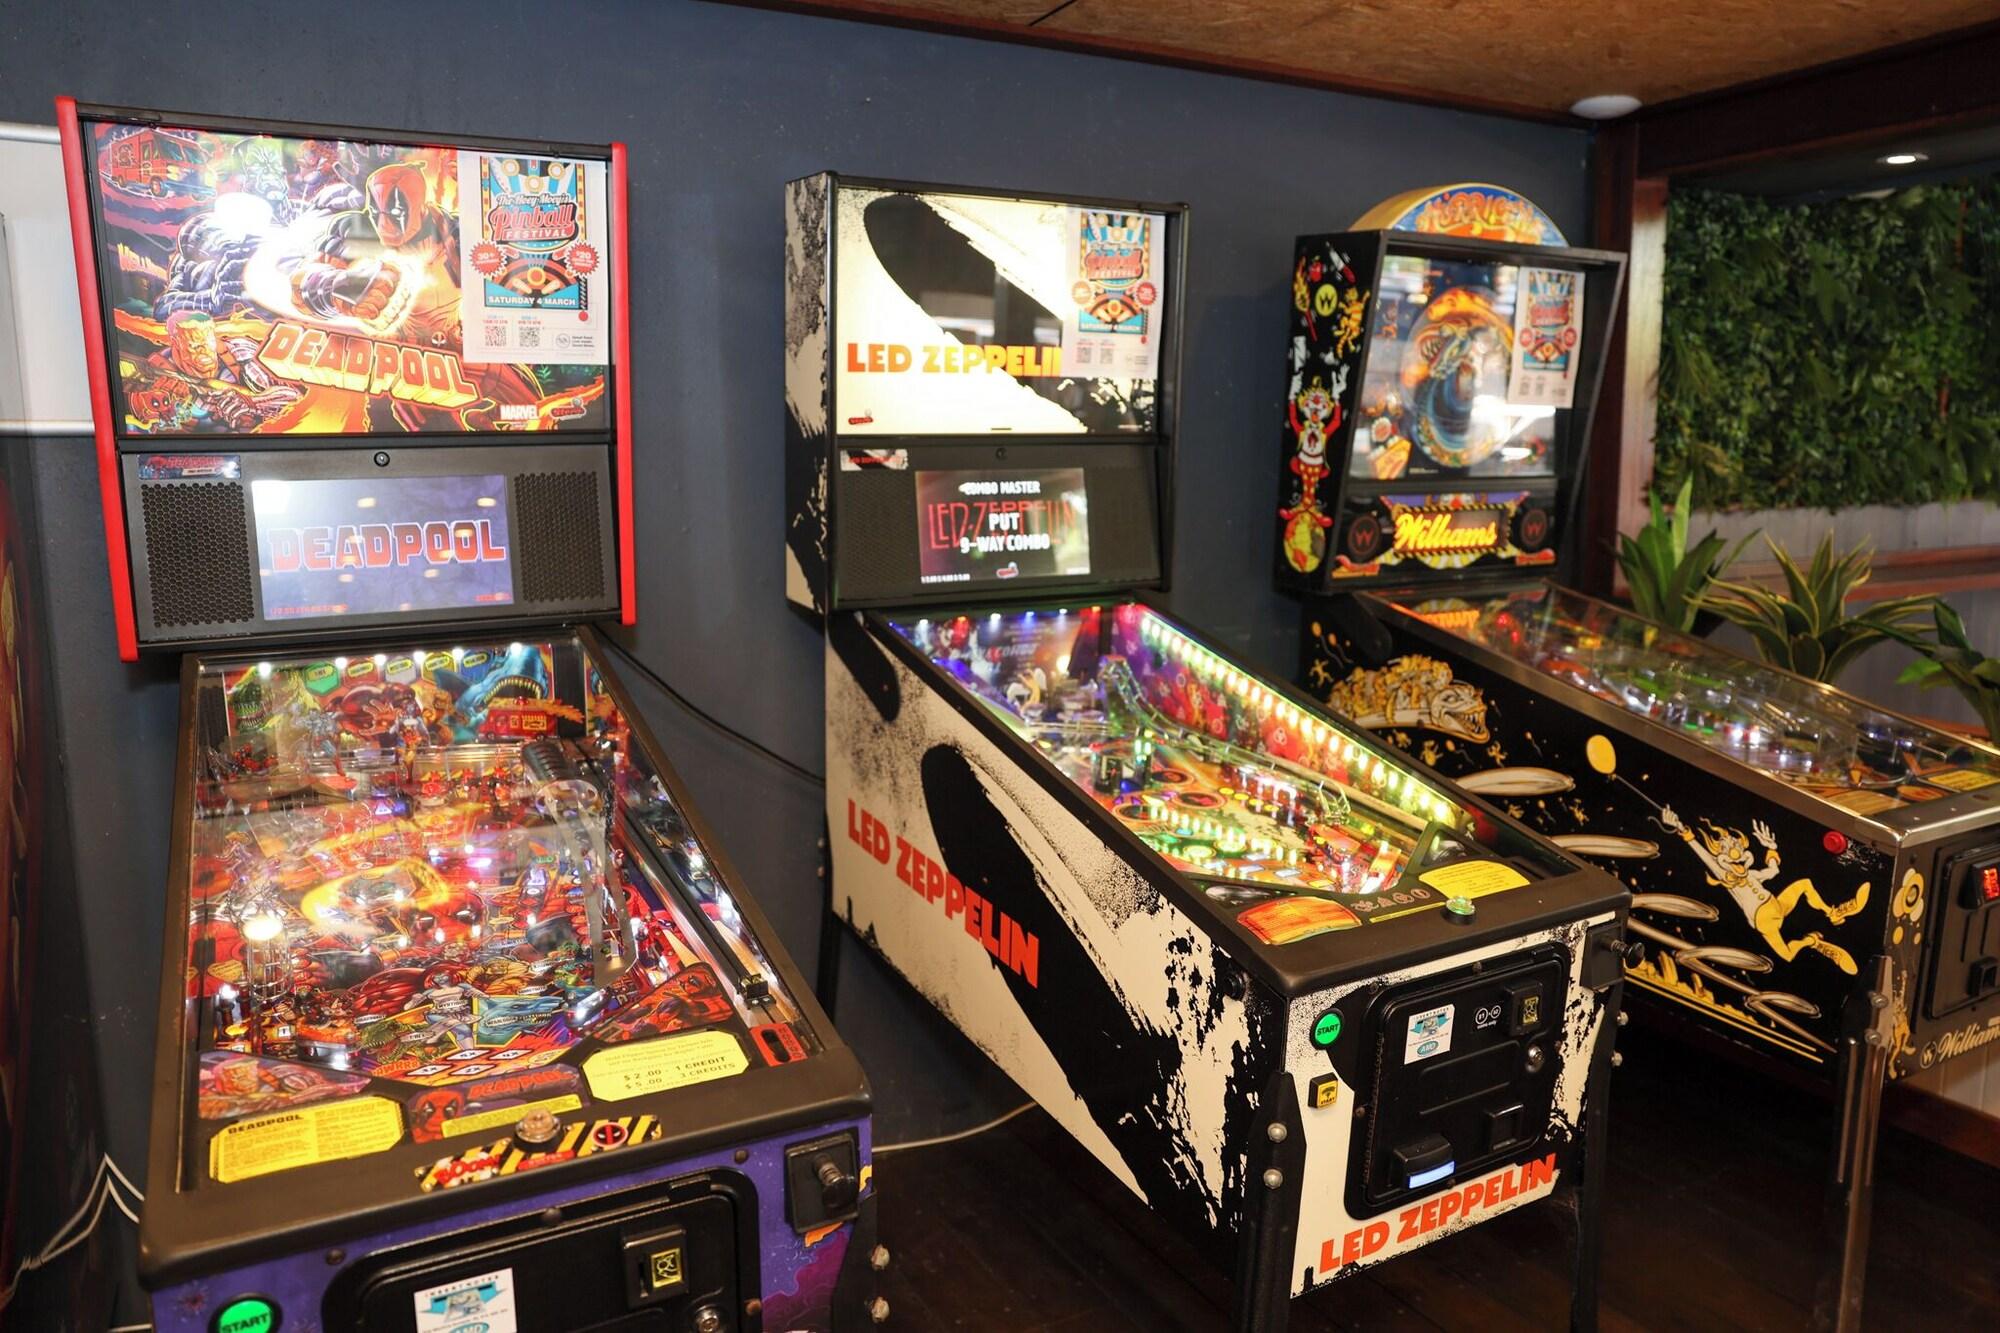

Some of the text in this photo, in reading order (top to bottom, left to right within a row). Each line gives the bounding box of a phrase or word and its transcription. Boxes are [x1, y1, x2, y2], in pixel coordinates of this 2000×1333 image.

[491, 204, 575, 240] Pinball
[506, 229, 567, 238] FESTIVAL
[489, 296, 535, 304] SATURDAY
[544, 297, 576, 306] MARCH
[258, 322, 479, 408] DEADPOOL
[847, 343, 912, 373] LED
[500, 405, 537, 420] MARVEL
[1000, 481, 1041, 495] MASTER
[988, 512, 1020, 530] PUT
[1393, 512, 1498, 550] Williams
[269, 520, 506, 573] DEADPOOL
[960, 534, 1050, 554] 9-WAY COMBO
[848, 797, 1039, 989] LED ZEPPELIN
[1317, 1023, 1340, 1036] START
[1937, 1022, 2000, 1063] William
[684, 1055, 727, 1070] CREDIT
[689, 1062, 736, 1077] CREDITS
[467, 1069, 580, 1099] DEADPOOL
[227, 1114, 305, 1135] DEADPOOL
[1319, 1152, 1557, 1274] LED ZEPPELIN
[222, 1313, 268, 1333] START
